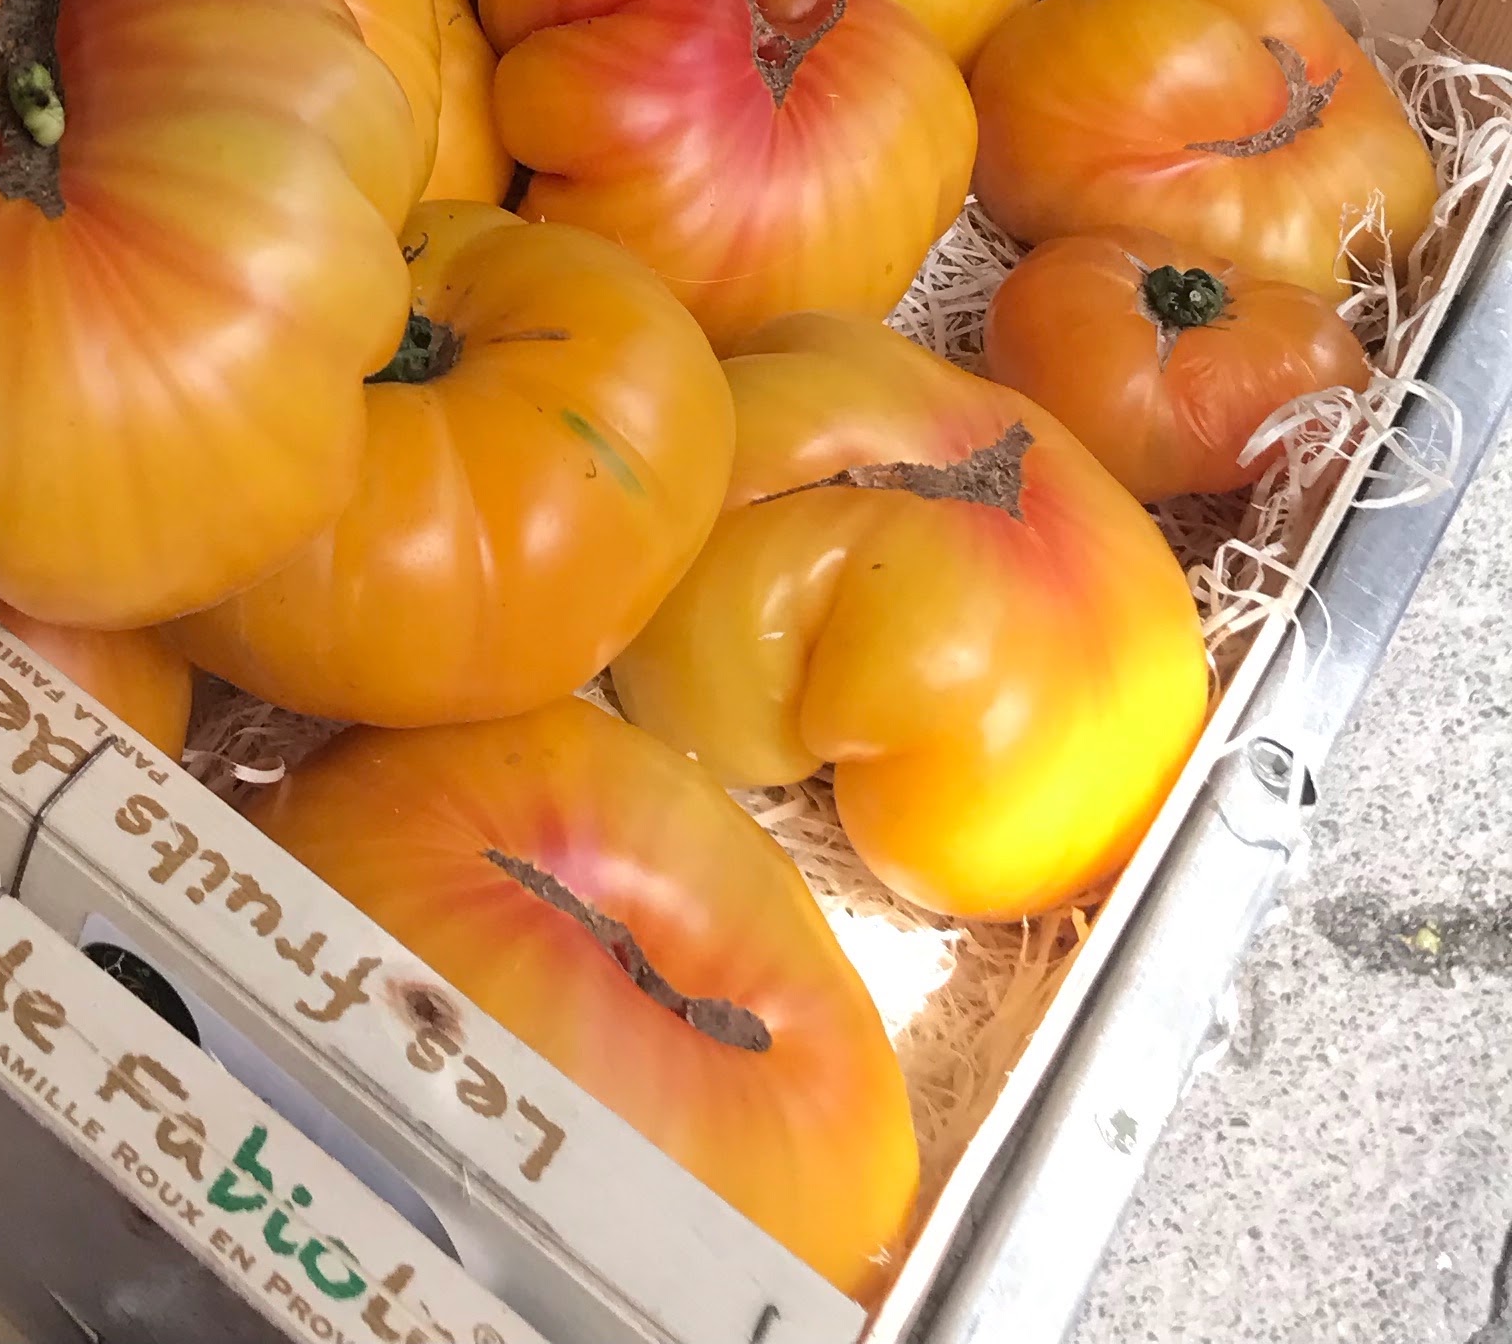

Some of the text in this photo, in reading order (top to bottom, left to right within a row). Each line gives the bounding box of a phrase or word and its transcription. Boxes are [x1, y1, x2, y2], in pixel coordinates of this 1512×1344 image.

[74, 703, 109, 737] LA
[113, 736, 170, 787] PAR
[114, 793, 384, 1023] fruits
[405, 1025, 568, 1183] Les
[111, 1141, 205, 1228] ROUX
[210, 1227, 256, 1273] EN
